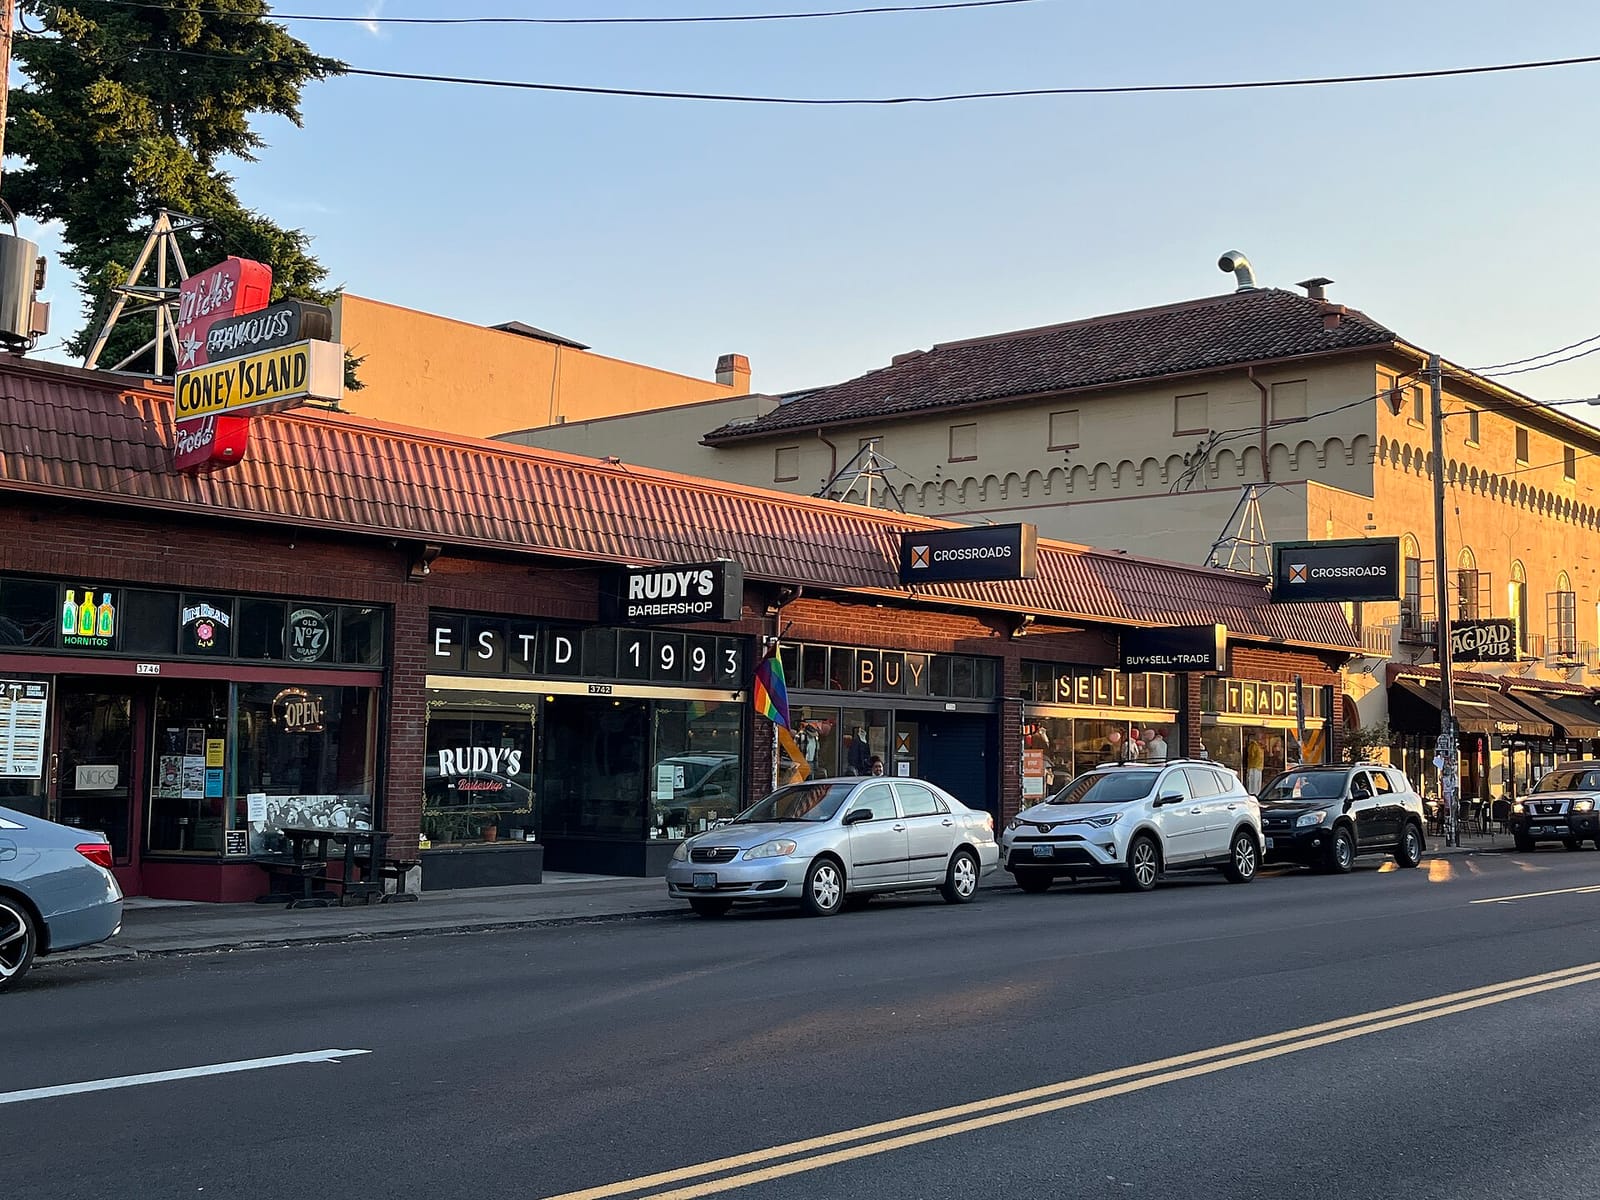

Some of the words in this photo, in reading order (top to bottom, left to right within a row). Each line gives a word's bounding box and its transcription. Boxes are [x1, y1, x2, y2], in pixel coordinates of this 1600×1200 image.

[206, 310, 292, 353] FAMOUS
[178, 367, 236, 411] CONEY
[239, 353, 307, 399] ISLAND
[933, 546, 1012, 561] CROSSROADS
[629, 569, 714, 599] RUDY'S
[1311, 566, 1387, 578] CROSSROADS
[628, 601, 713, 616] BARBERSHOP
[302, 619, 318, 627] OLD
[64, 636, 109, 647] HORNITOS
[435, 628, 572, 664] ESTD
[629, 641, 737, 674] 1993
[1451, 625, 1511, 655] AGDAD
[1478, 642, 1511, 656] PUB
[861, 659, 924, 687] BUY
[589, 685, 611, 694] 3742
[1060, 676, 1126, 700] SELL
[1229, 688, 1298, 711] TRADE
[286, 701, 320, 727] OPEN
[438, 747, 523, 777] RUDY'S
